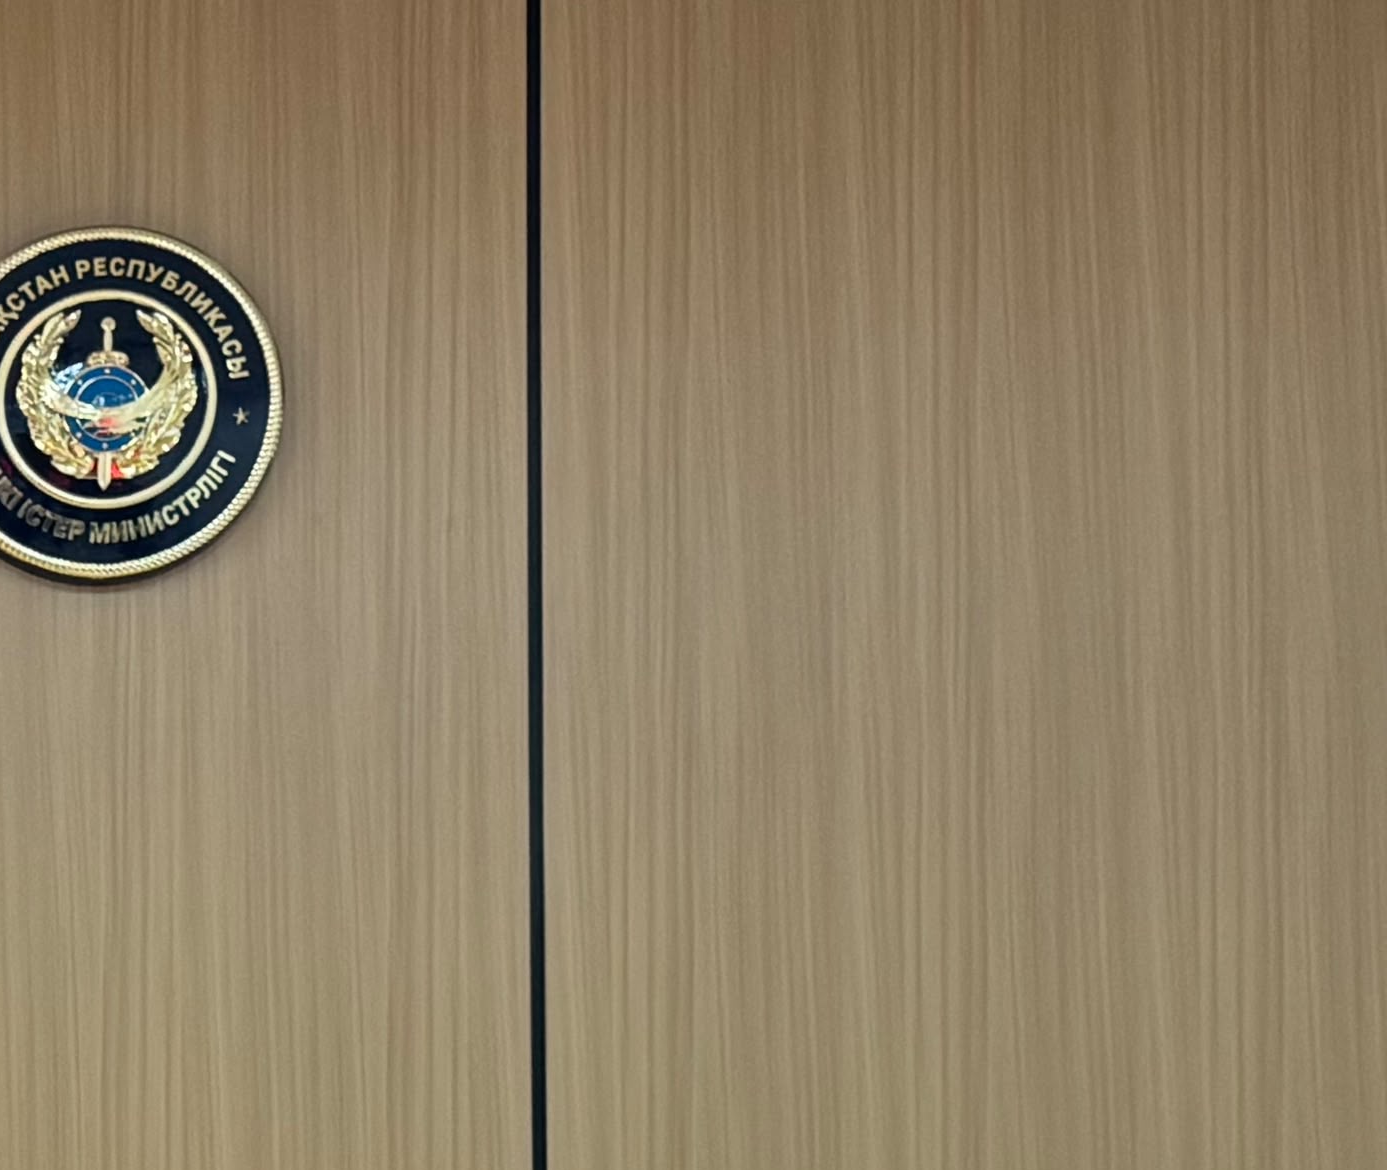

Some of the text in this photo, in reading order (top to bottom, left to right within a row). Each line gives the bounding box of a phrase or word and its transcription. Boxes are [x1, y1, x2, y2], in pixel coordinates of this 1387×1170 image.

[75, 256, 250, 380] РЕСПУБЛИКАСЫ
[17, 498, 86, 542] ІСТЕР
[89, 450, 236, 544] МИНИСТРЛІГІ
